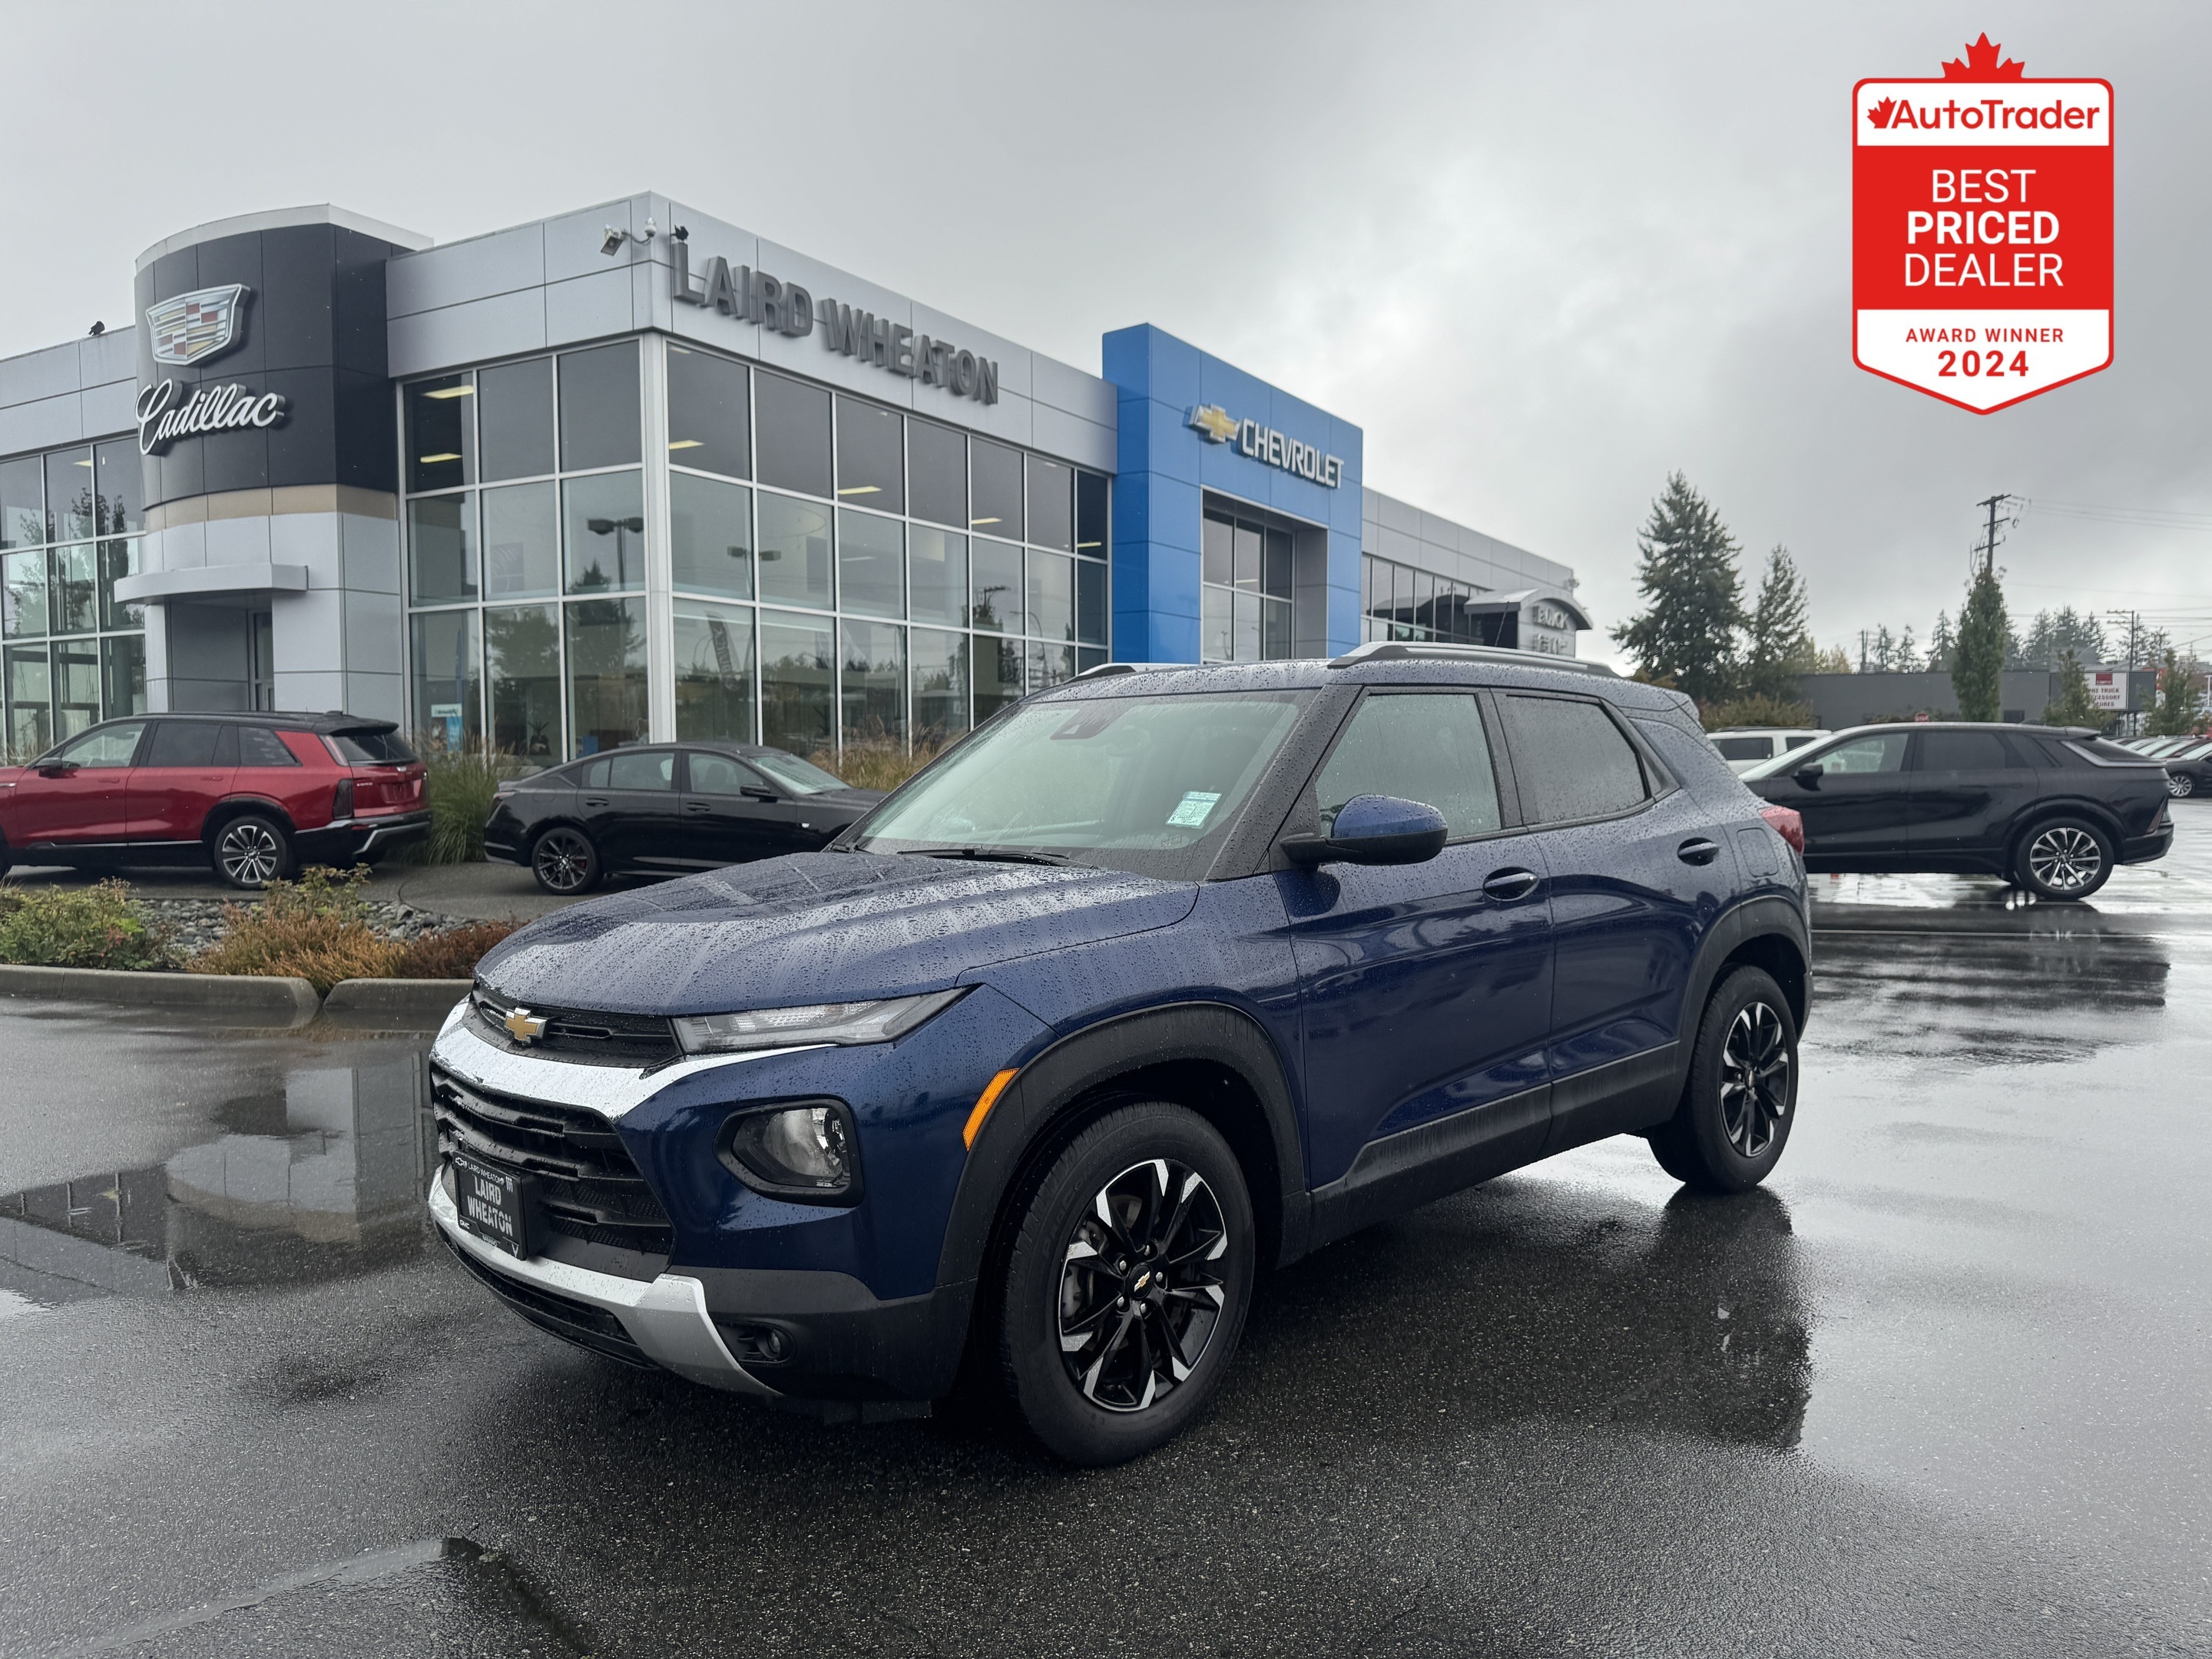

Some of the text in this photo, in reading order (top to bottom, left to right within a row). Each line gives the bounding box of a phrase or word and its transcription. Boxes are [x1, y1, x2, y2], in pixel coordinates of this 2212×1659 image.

[672, 240, 998, 405] LAIRD WHEATON
[134, 378, 281, 456] Cadillac
[1240, 417, 1344, 489] CHEVROLET
[467, 1195, 513, 1237] WHEATON
[473, 1174, 502, 1206] LAIRD
